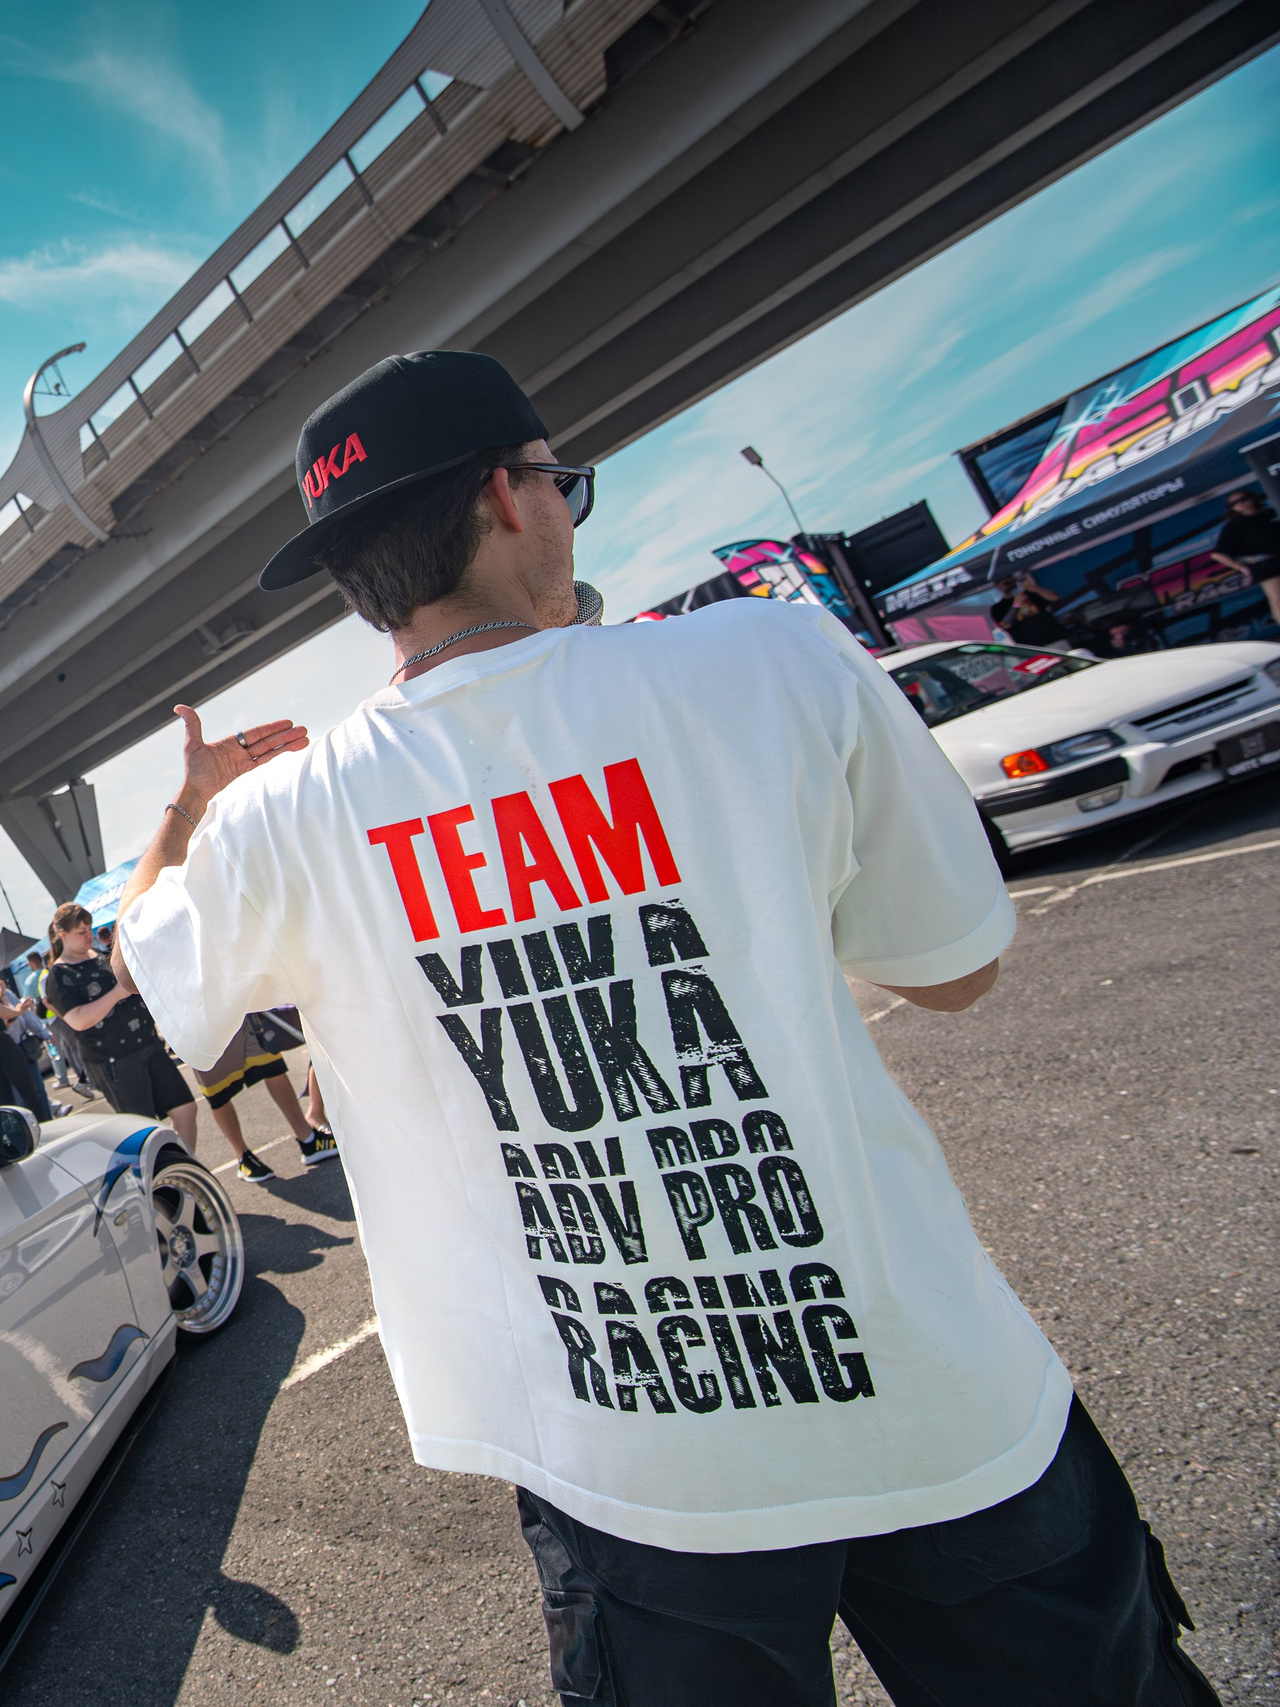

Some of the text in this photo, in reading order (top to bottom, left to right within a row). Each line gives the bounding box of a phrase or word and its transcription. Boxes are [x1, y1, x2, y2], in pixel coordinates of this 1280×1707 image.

[302, 432, 368, 510] YUKA
[1012, 352, 1280, 530] RACIN
[1007, 477, 1185, 563] ГОНОЧНЫЕ СИМУЛЯТОРЫ
[886, 566, 973, 614] META
[367, 757, 681, 942] TEAM
[436, 965, 769, 1132] YUKA
[515, 1180, 648, 1265] ADV
[661, 1155, 824, 1261] PRO
[552, 1304, 876, 1414] RACING
